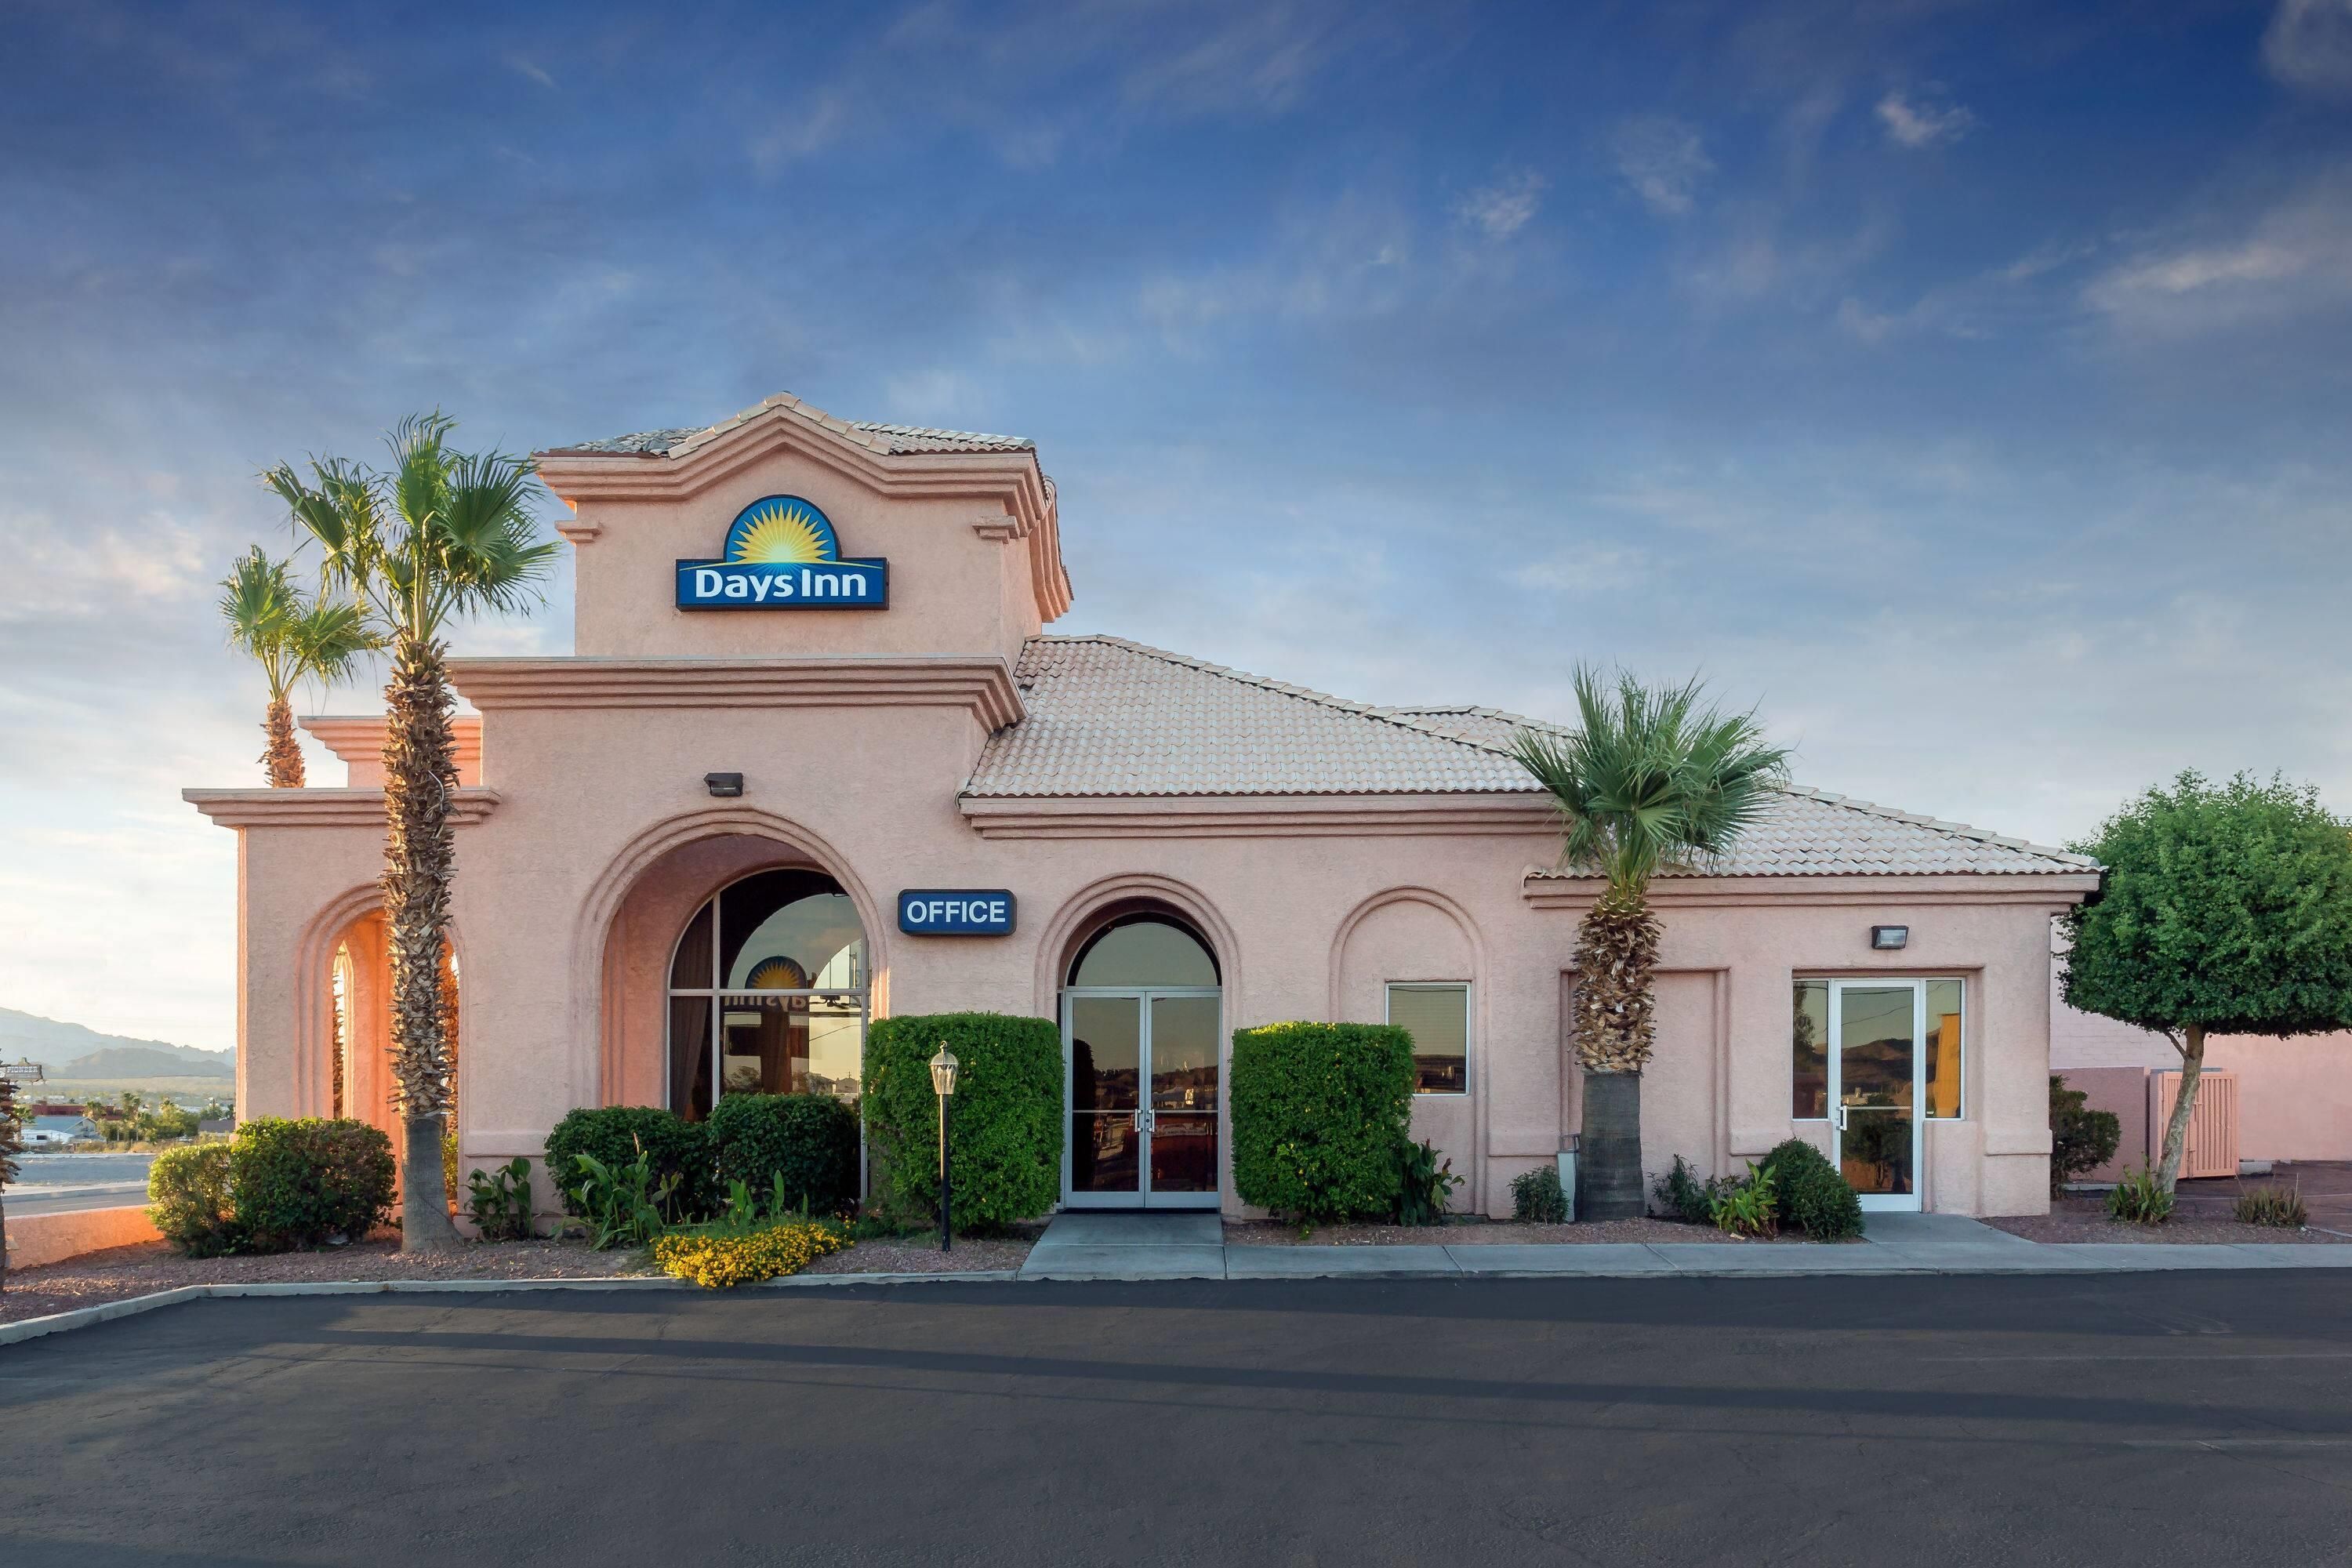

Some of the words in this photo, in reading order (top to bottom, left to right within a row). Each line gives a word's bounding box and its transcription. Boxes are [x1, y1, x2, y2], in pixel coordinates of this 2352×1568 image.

[695, 569, 794, 602] Days
[801, 569, 866, 597] Inn
[906, 900, 1006, 924] OFFICE
